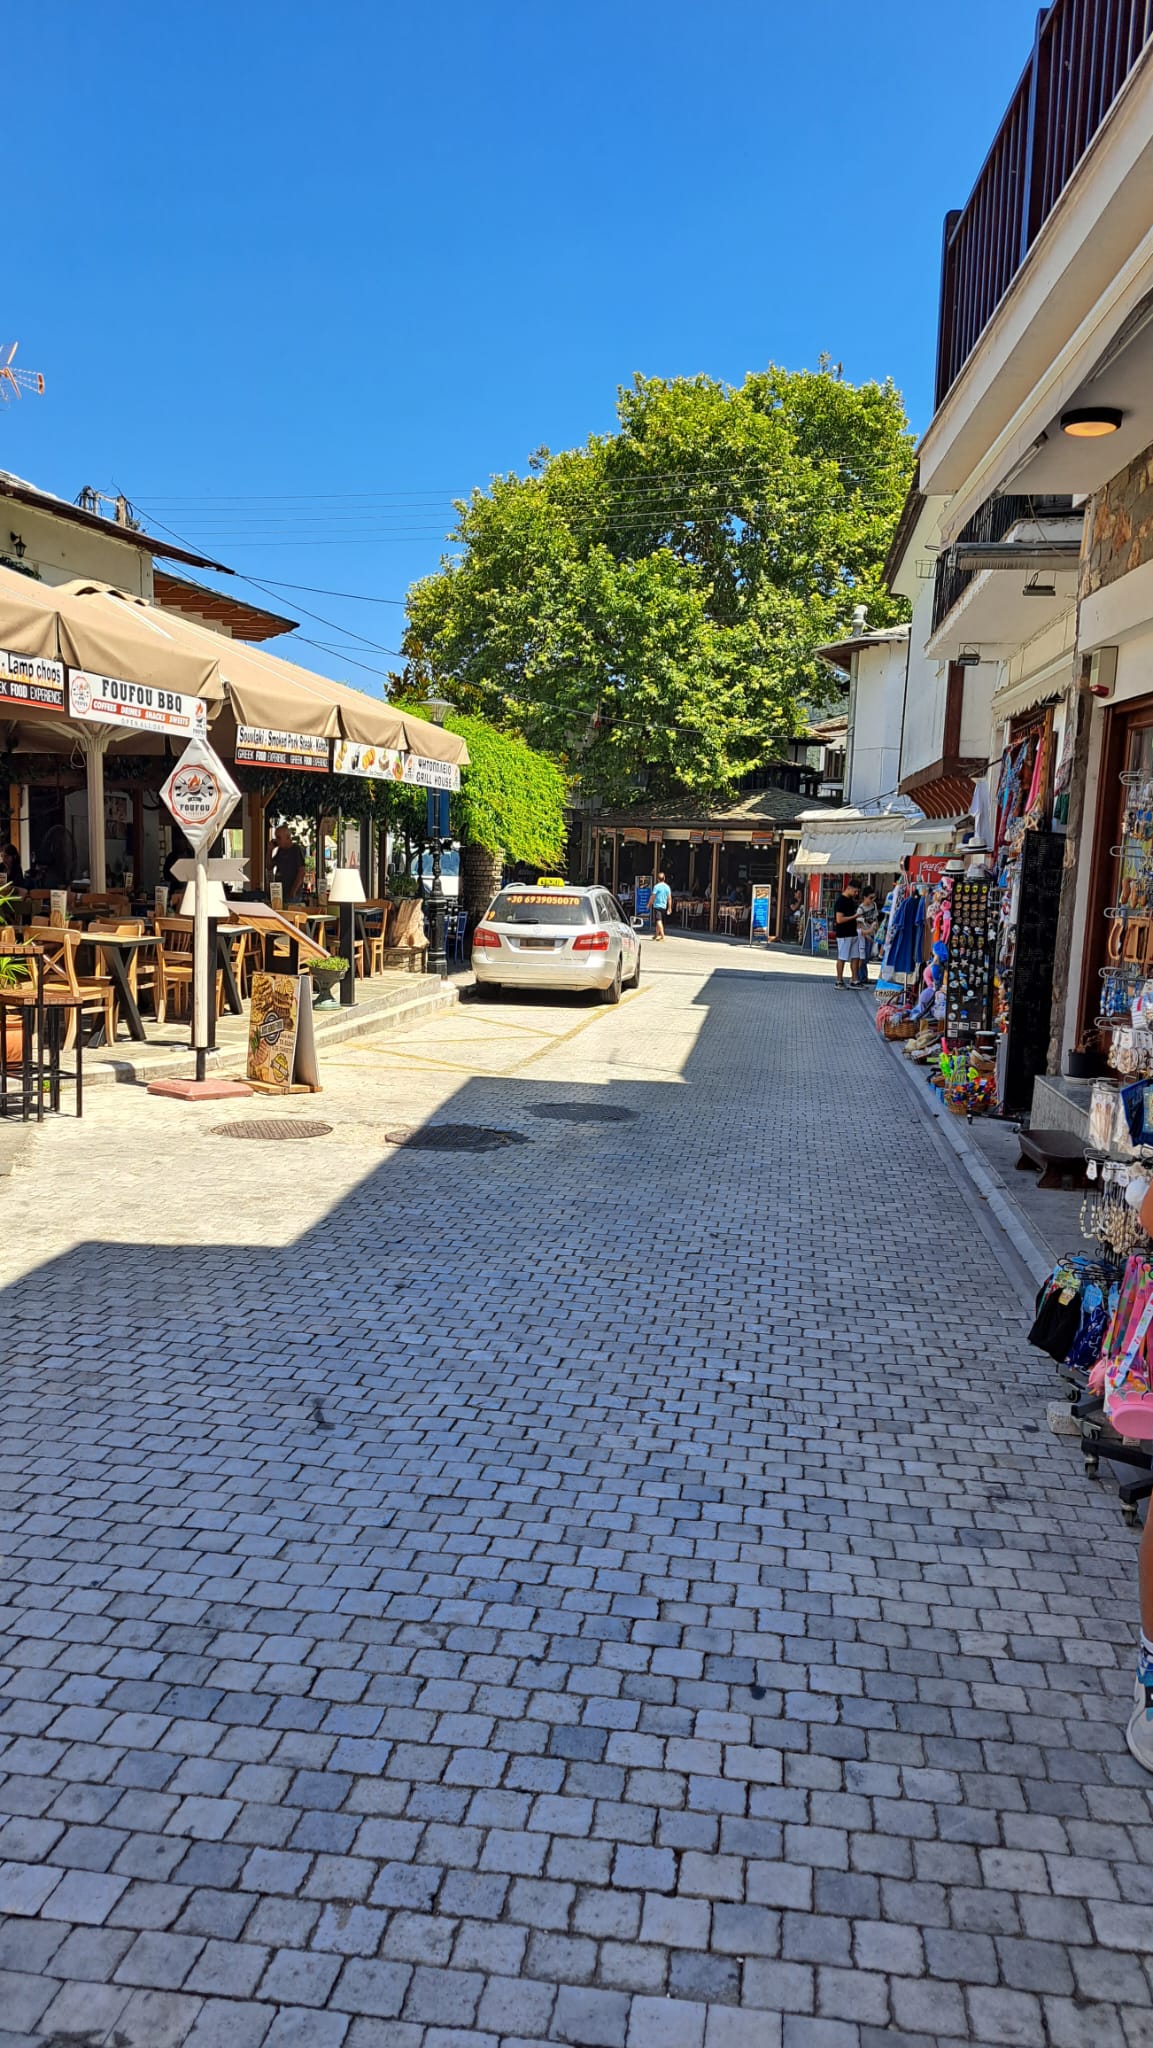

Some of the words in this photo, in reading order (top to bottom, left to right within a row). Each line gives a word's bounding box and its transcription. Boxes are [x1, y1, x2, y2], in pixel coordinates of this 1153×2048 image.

[8, 653, 34, 678] Lamp
[36, 661, 62, 684] chops
[10, 682, 28, 699] FOOD
[30, 687, 63, 705] EXPERIENCE
[102, 678, 153, 707] FOUFOU
[157, 691, 182, 714] BBQ
[240, 727, 265, 744] Souvlaki
[268, 731, 287, 747] Smoked
[238, 749, 254, 760] GREEK
[255, 750, 267, 762] FOOD
[416, 771, 432, 785] GRILL
[434, 776, 452, 788] HOUSE
[180, 804, 210, 812] FOUFOU
[506, 895, 523, 903] +30
